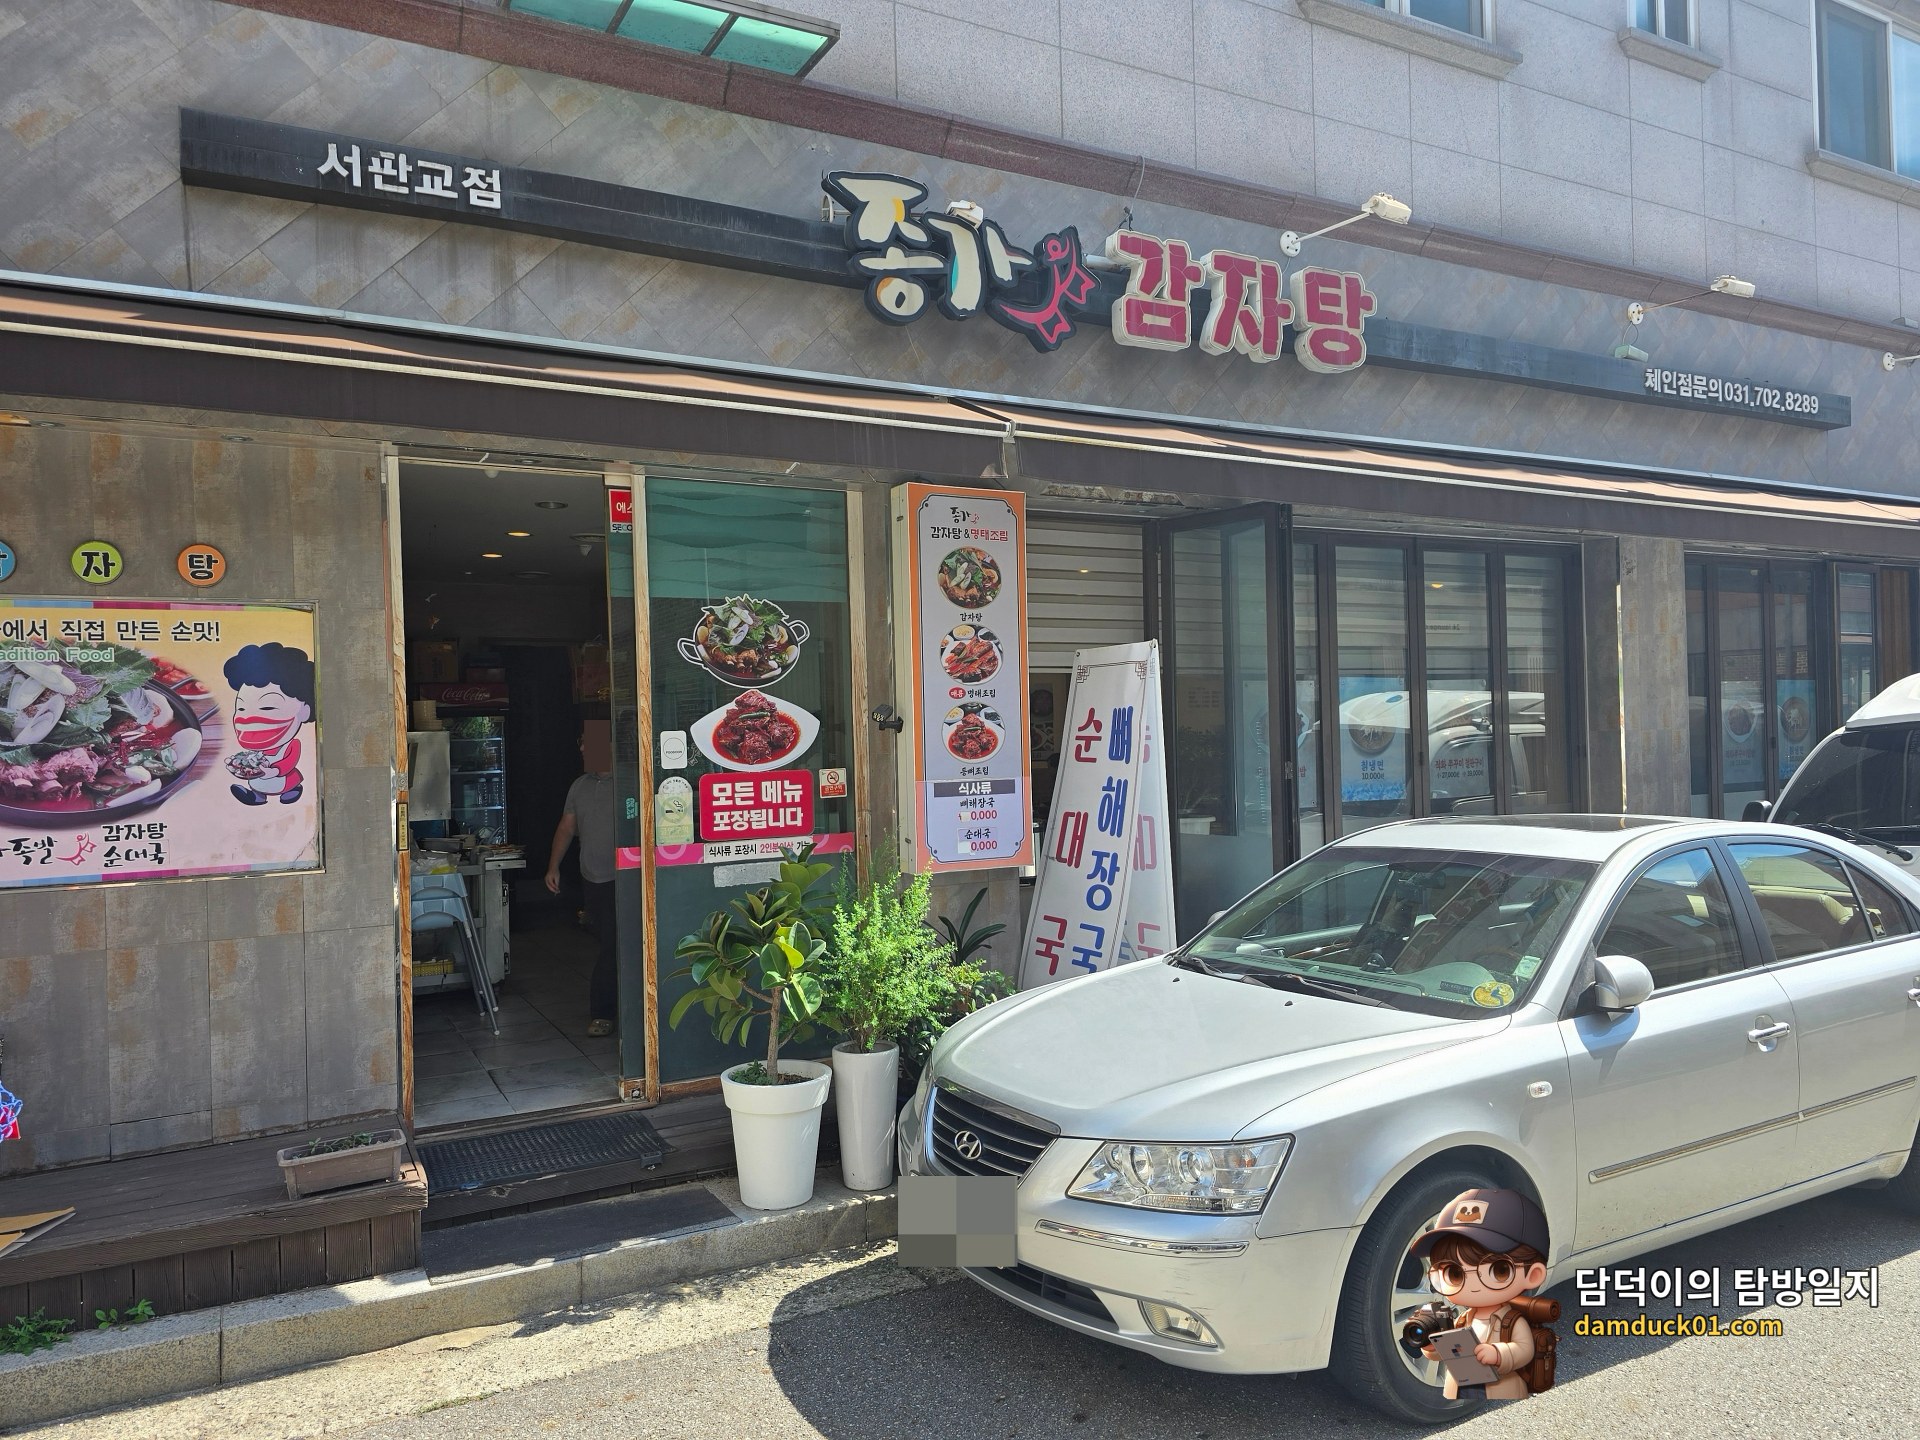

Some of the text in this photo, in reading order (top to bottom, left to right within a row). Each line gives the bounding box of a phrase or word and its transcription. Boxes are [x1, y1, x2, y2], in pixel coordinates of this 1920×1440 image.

[317, 142, 503, 210] 서판교점
[824, 170, 1377, 375] 종가 감자탕
[950, 507, 971, 523] 종가
[931, 526, 1008, 541] 감자탕 & 명태조림
[81, 551, 218, 580] 자 탕
[960, 612, 983, 622] 감자탕
[0, 619, 220, 642] 에서 직접 만든 손맛!
[0, 648, 114, 662] adition Food
[712, 782, 754, 806] 모든
[761, 780, 803, 803] 메뉴
[959, 781, 992, 795] 식사류
[960, 797, 995, 809] 뼈해장국
[713, 807, 804, 832] 포장됩니다
[102, 822, 168, 843] 감자탕
[965, 828, 991, 840] 순대국
[0, 836, 57, 866] 족발
[103, 842, 167, 868] 순대국
[708, 845, 732, 857] 식사류
[734, 843, 757, 856] 포장시
